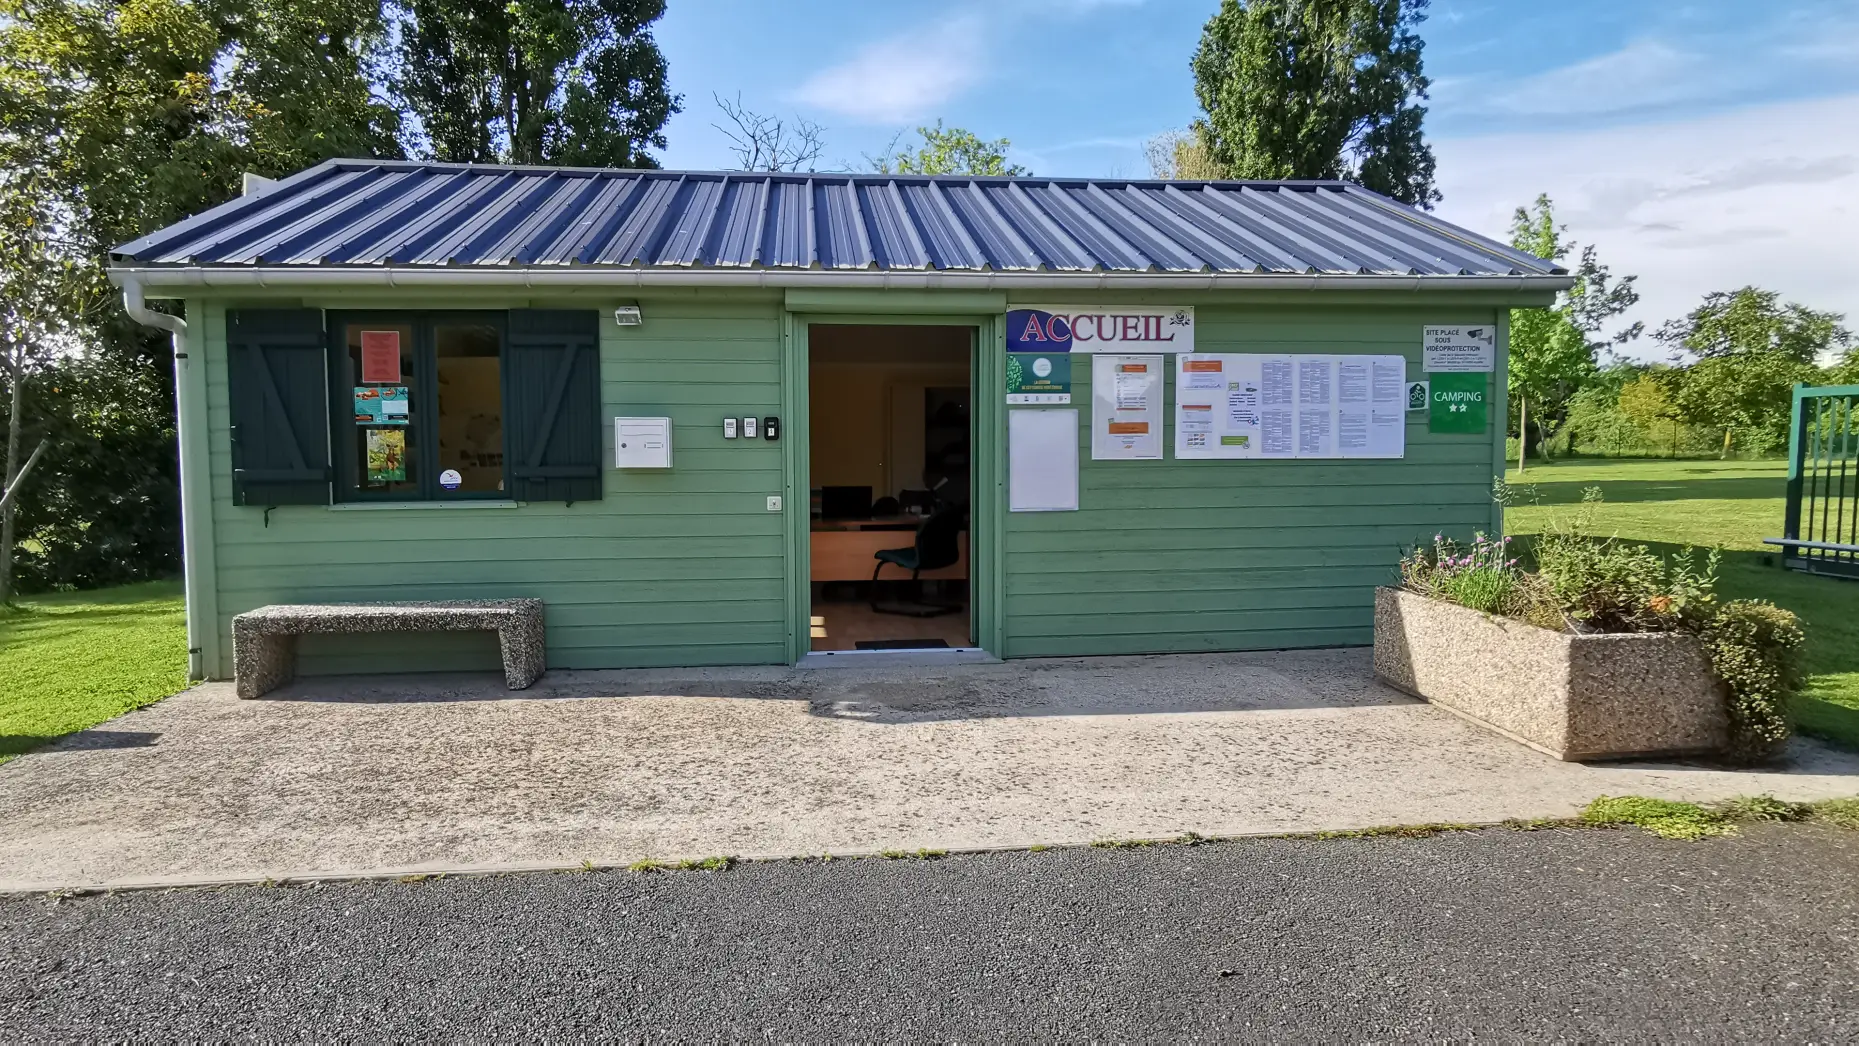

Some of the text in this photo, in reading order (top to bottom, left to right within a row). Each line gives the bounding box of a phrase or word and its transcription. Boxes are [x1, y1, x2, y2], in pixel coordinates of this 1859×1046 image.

[1019, 313, 1175, 342] ACCUEIL
[1440, 328, 1459, 336] PLACÉ
[1426, 344, 1481, 352] VIDÉOPROTECTION
[1434, 391, 1482, 402] CAMPING
